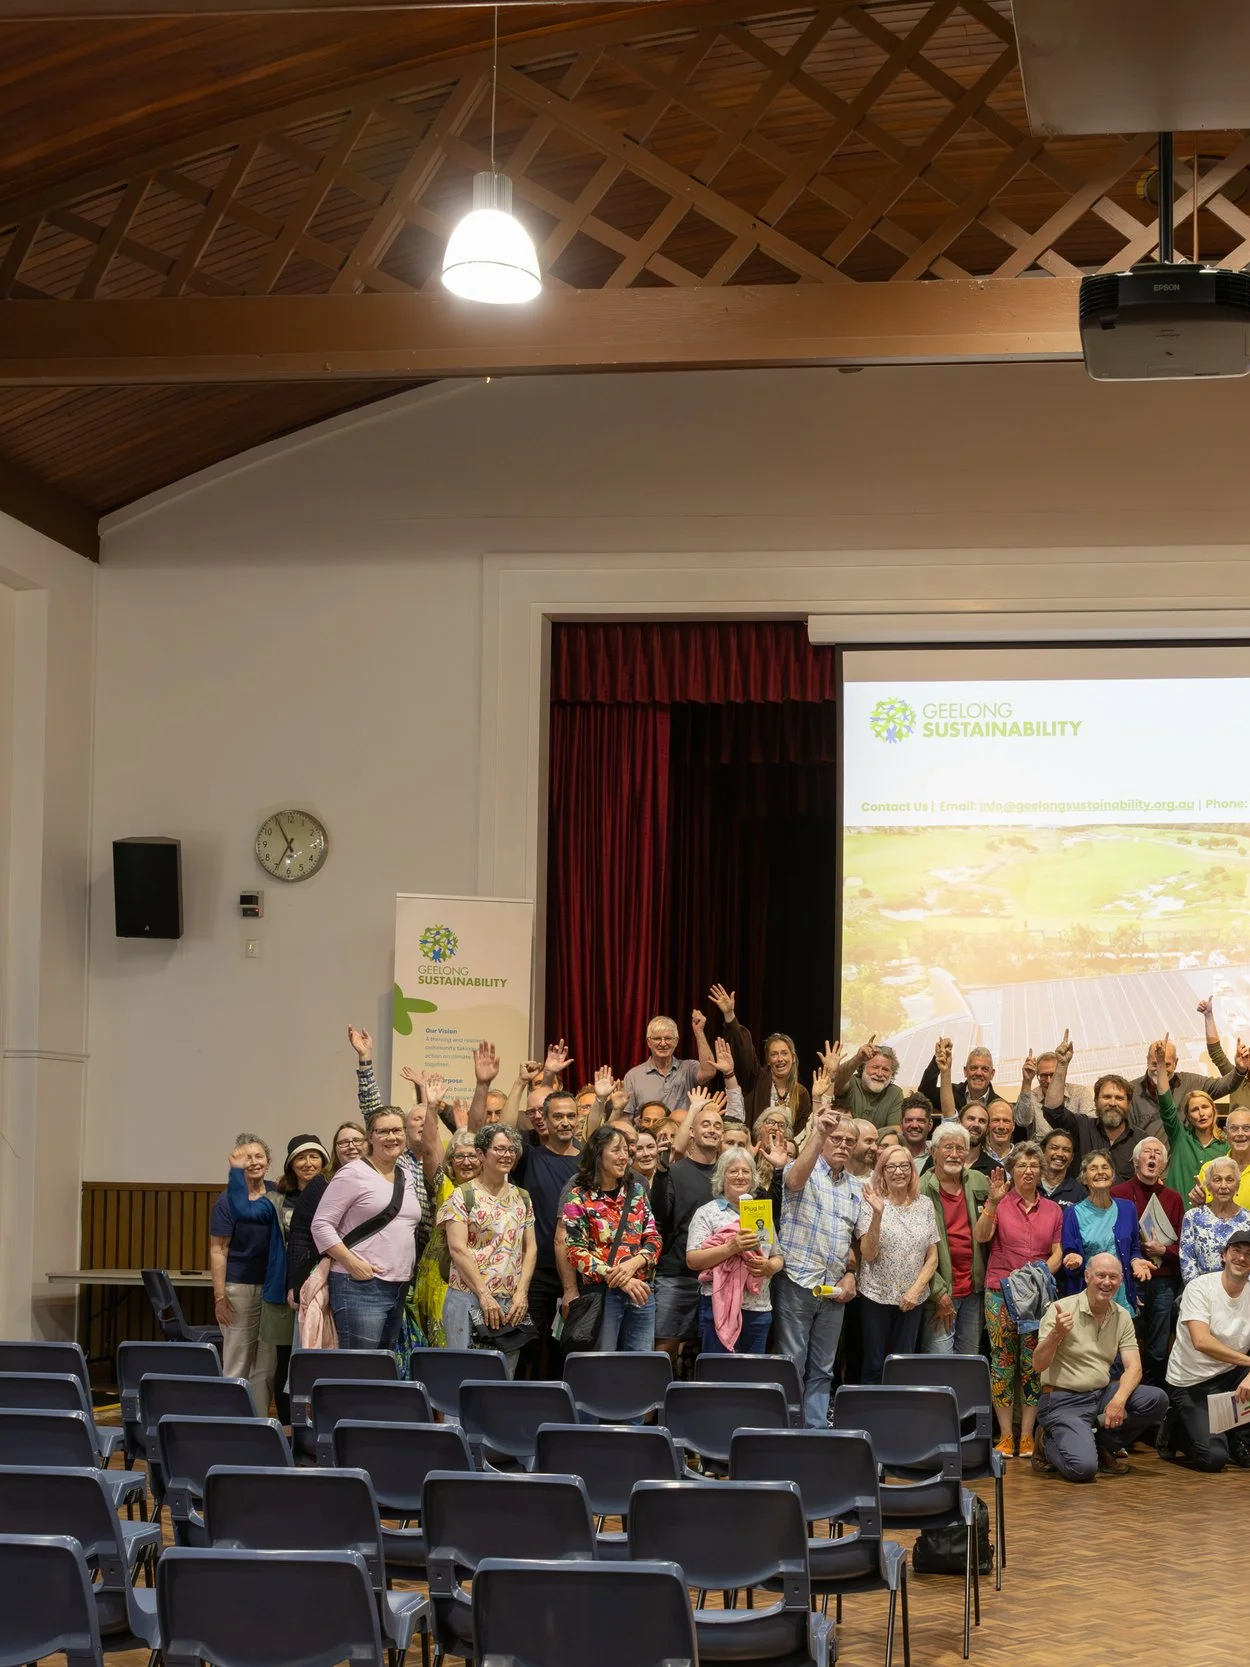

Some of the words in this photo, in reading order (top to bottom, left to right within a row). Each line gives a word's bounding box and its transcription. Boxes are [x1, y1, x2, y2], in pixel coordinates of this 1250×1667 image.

[922, 702, 1012, 719] GEELONG
[922, 720, 1082, 738] SUSTAINABILITY
[861, 802, 911, 812] Contact
[914, 801, 928, 812] Us
[939, 800, 977, 812] Email:
[980, 799, 1194, 813] info@geelongsustainability.org.au
[1205, 799, 1248, 809] Phone:
[287, 815, 294, 824] 12
[264, 827, 272, 836] 10
[262, 840, 267, 848] 9
[265, 853, 270, 861] 8
[308, 854, 314, 862] 4
[286, 867, 291, 875] 6
[299, 863, 304, 871] 5
[418, 965, 469, 976] GEELONG
[418, 976, 508, 988] SUSTAINABILITY
